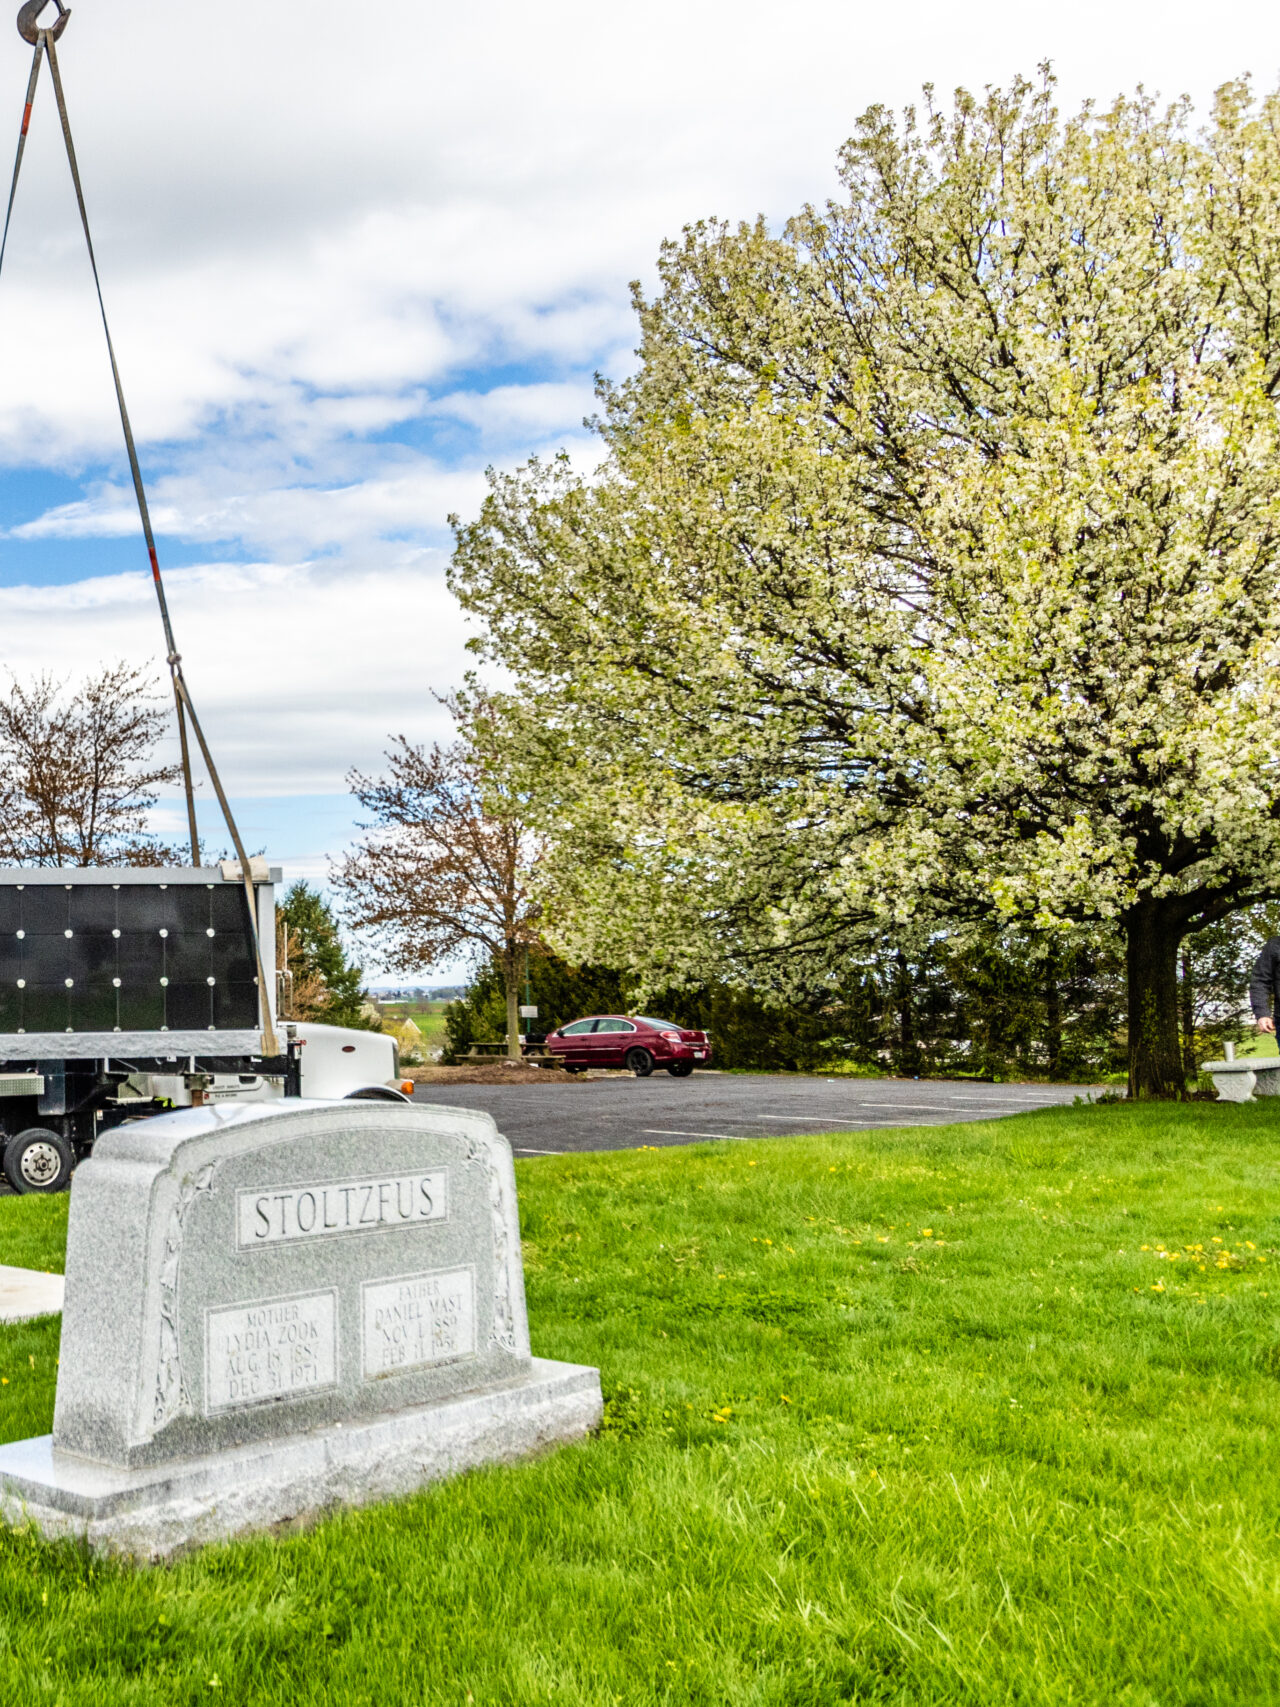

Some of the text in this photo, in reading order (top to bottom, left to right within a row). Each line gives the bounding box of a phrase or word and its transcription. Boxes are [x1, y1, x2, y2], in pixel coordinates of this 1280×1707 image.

[254, 1177, 434, 1239] STOLTZFUS
[399, 1280, 441, 1301] FATHER
[247, 1304, 299, 1328] MOTHER
[375, 1293, 463, 1323] DANIEL MAST
[226, 1320, 318, 1354] LYDIA ZOOK
